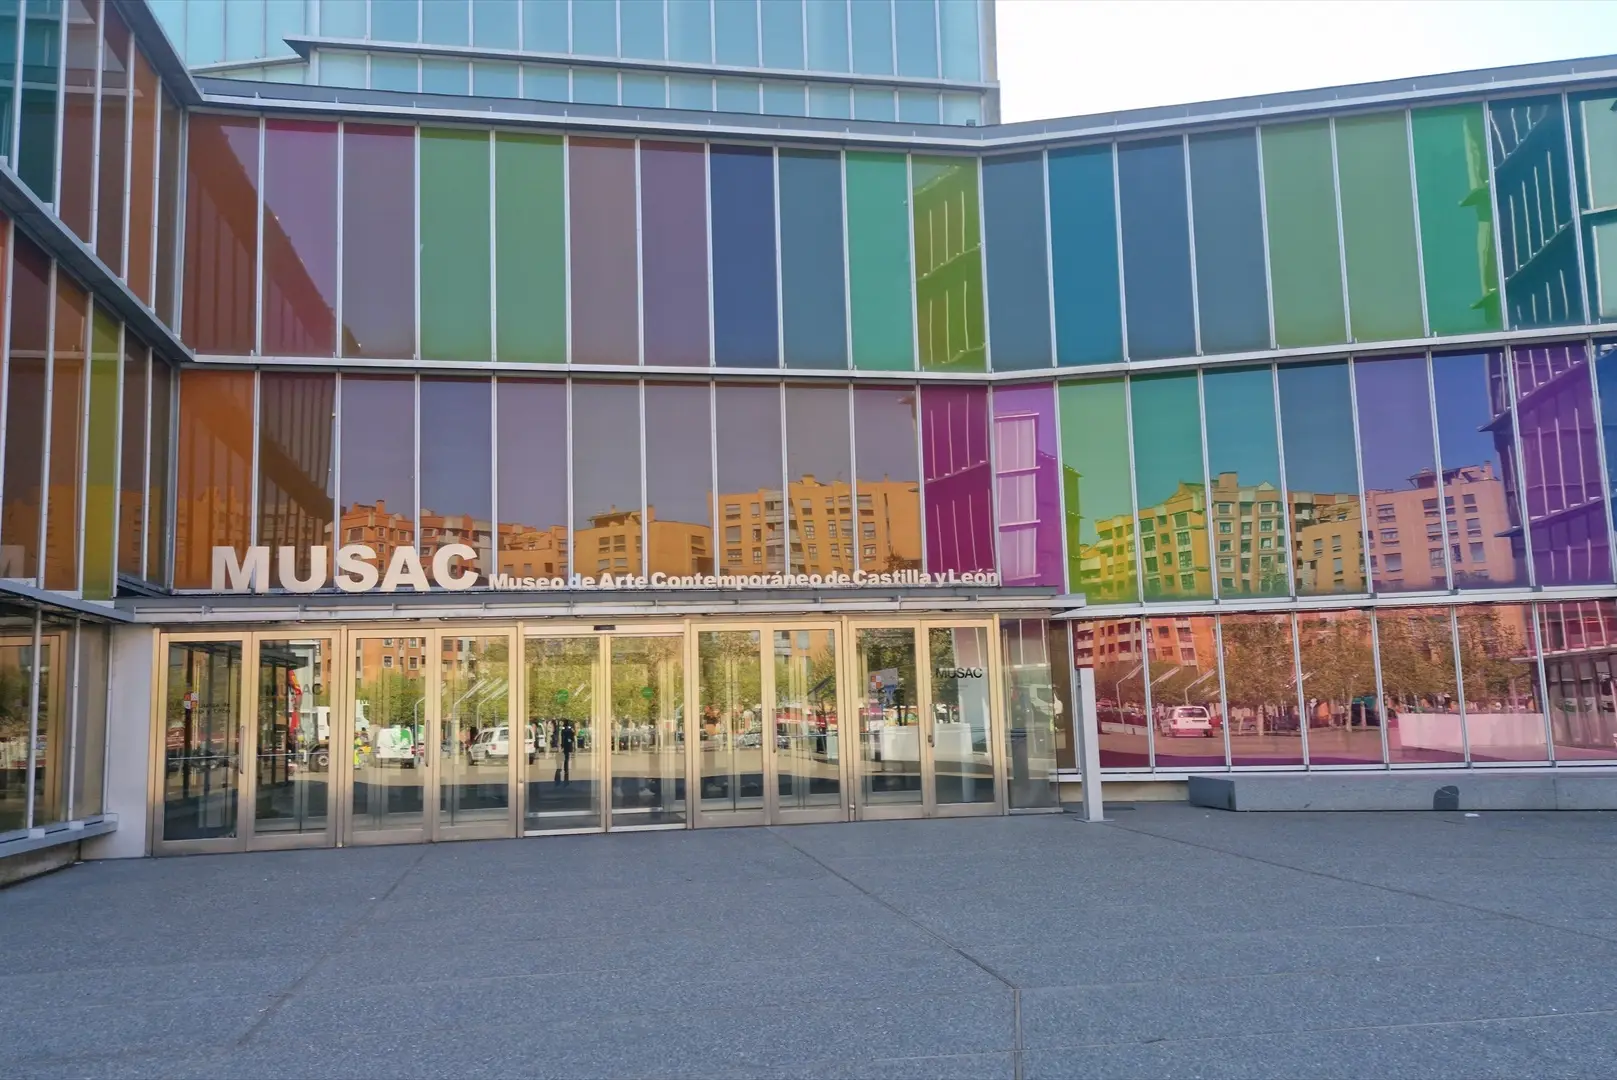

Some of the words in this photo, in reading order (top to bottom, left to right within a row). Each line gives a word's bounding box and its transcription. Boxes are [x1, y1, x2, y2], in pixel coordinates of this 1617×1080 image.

[212, 543, 479, 593] MUSAC
[488, 573, 565, 590] Museo
[568, 573, 594, 588] de
[600, 572, 647, 588] Arte
[651, 571, 823, 589] Contemporáneo
[826, 570, 851, 585] de
[853, 569, 931, 585] Castilla
[935, 572, 946, 588] y
[949, 568, 998, 586] León
[935, 667, 983, 679] MUSAC
